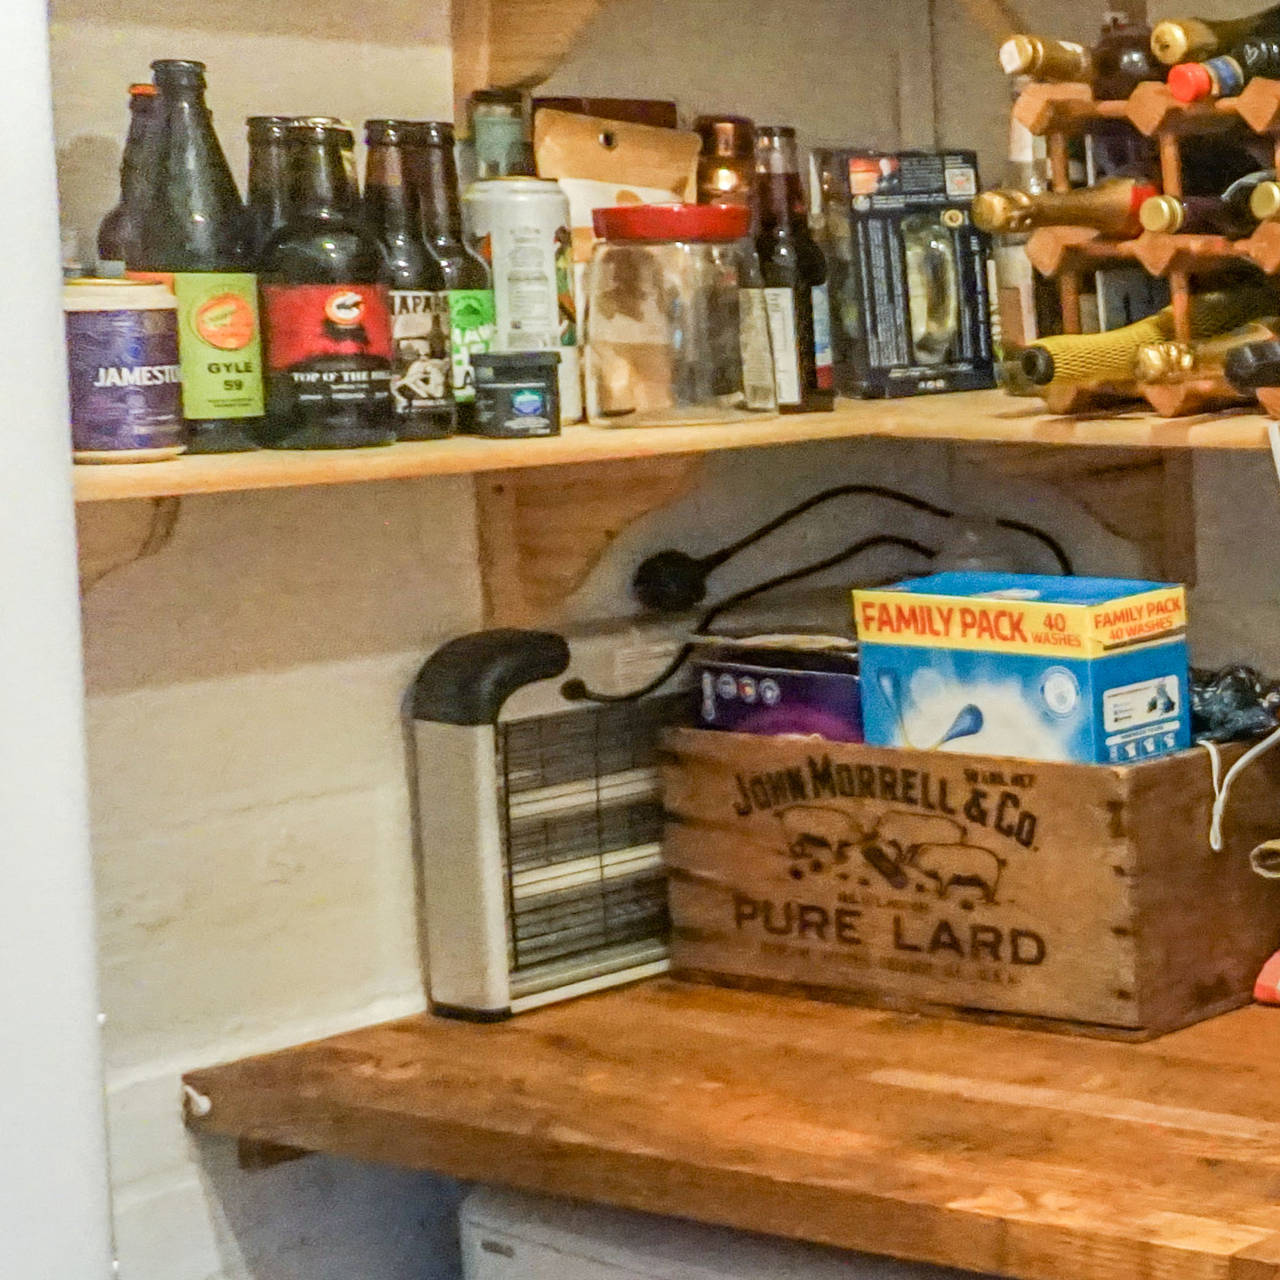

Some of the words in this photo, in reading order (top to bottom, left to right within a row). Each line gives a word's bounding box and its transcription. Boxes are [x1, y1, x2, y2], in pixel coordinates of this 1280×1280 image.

[208, 361, 252, 374] GYLE
[291, 372, 320, 383] TOP
[341, 371, 368, 382] THE
[224, 380, 243, 391] 59
[861, 601, 953, 637] FAMILY
[959, 608, 1028, 644] PACK
[1043, 613, 1066, 632] 40
[1094, 604, 1144, 630] FAMILY
[1146, 597, 1182, 618] PACK
[1109, 629, 1124, 641] 40
[1126, 617, 1173, 638] WASHES
[1031, 632, 1082, 648] WASHES
[807, 752, 957, 815] MORRELL
[733, 892, 863, 946] PURE
[892, 914, 1047, 967] LARD
